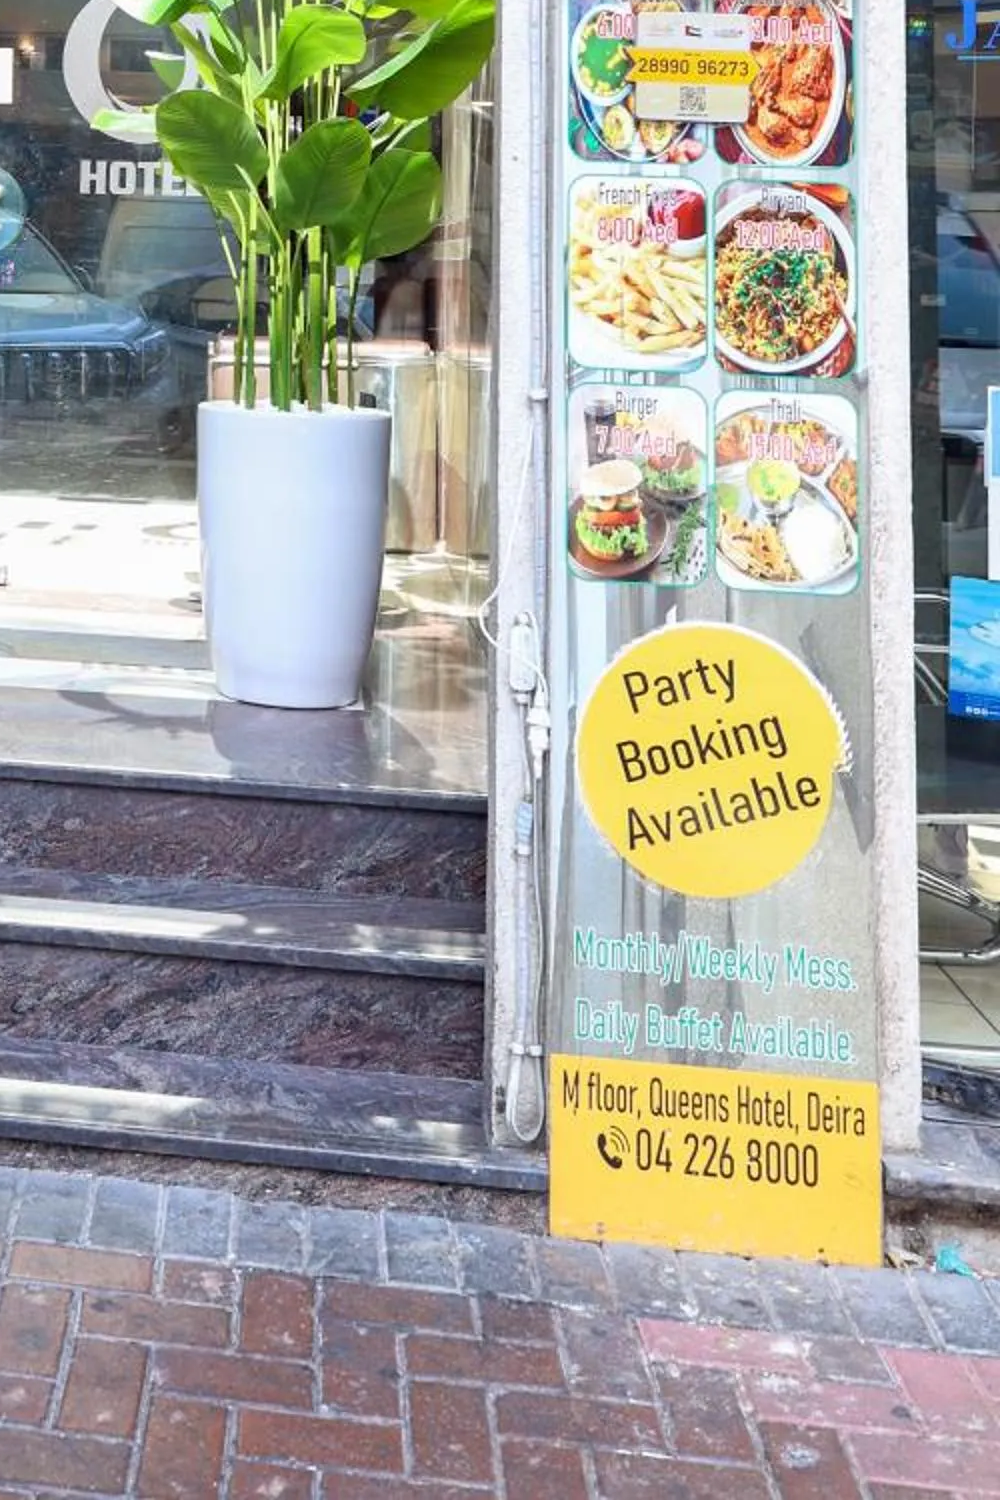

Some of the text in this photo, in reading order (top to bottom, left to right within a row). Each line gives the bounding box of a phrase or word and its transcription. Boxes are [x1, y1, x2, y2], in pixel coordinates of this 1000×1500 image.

[638, 57, 749, 77] 28990 96273
[599, 182, 641, 206] French
[615, 391, 659, 421] Burger
[622, 658, 735, 715] Party
[615, 715, 788, 783] Booking
[627, 771, 821, 851] Available
[575, 997, 638, 1054] Daily
[646, 1004, 723, 1051] Buffet
[587, 1072, 642, 1120] floor,
[650, 1076, 730, 1124] Queens
[737, 1085, 799, 1135] Hotel,
[808, 1092, 866, 1137] Deira
[635, 1128, 820, 1188] 04 226 8000
